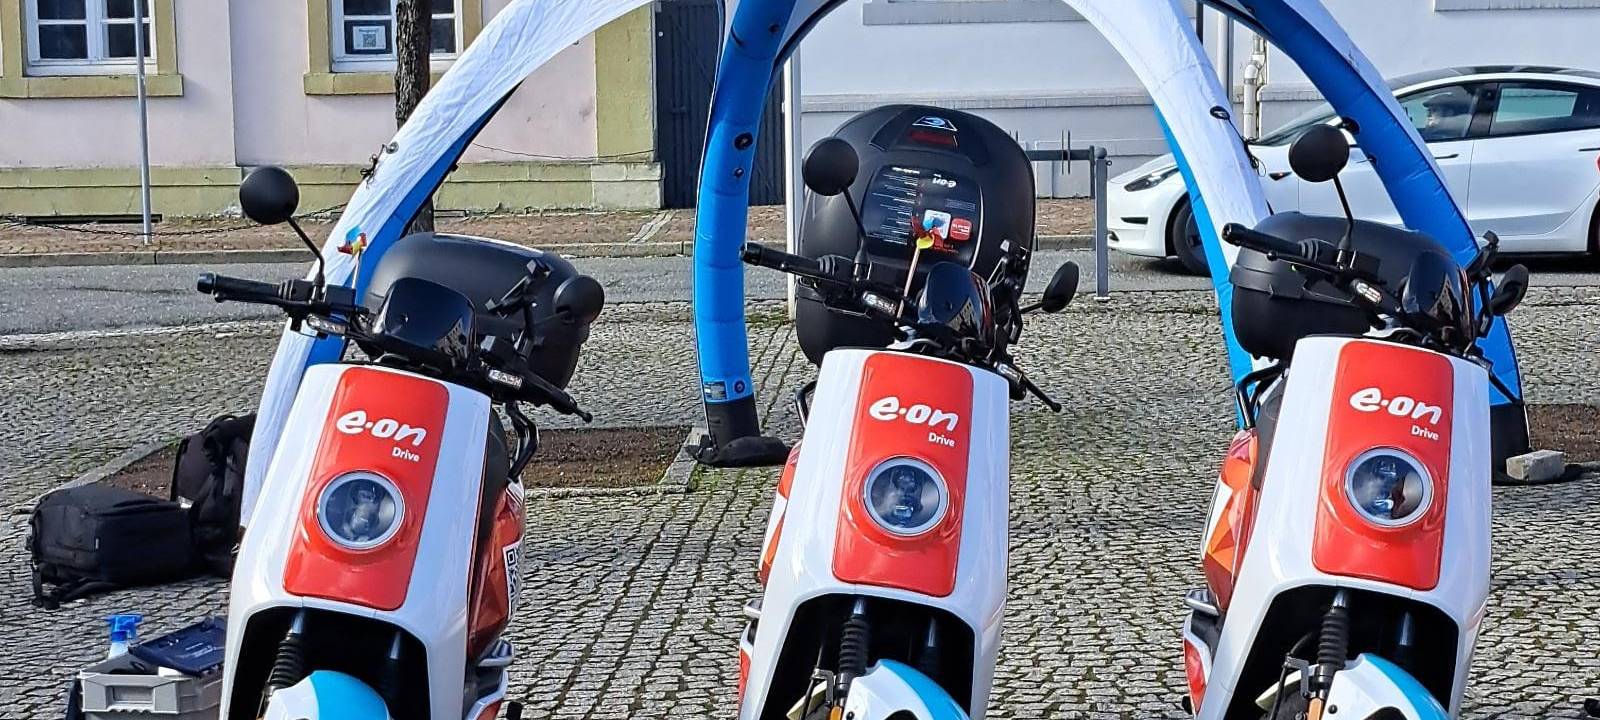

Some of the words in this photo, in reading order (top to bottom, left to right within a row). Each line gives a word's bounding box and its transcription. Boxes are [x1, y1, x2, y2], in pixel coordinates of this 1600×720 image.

[928, 432, 955, 447] Drive
[1411, 425, 1439, 440] Drive
[392, 447, 420, 462] Drive
